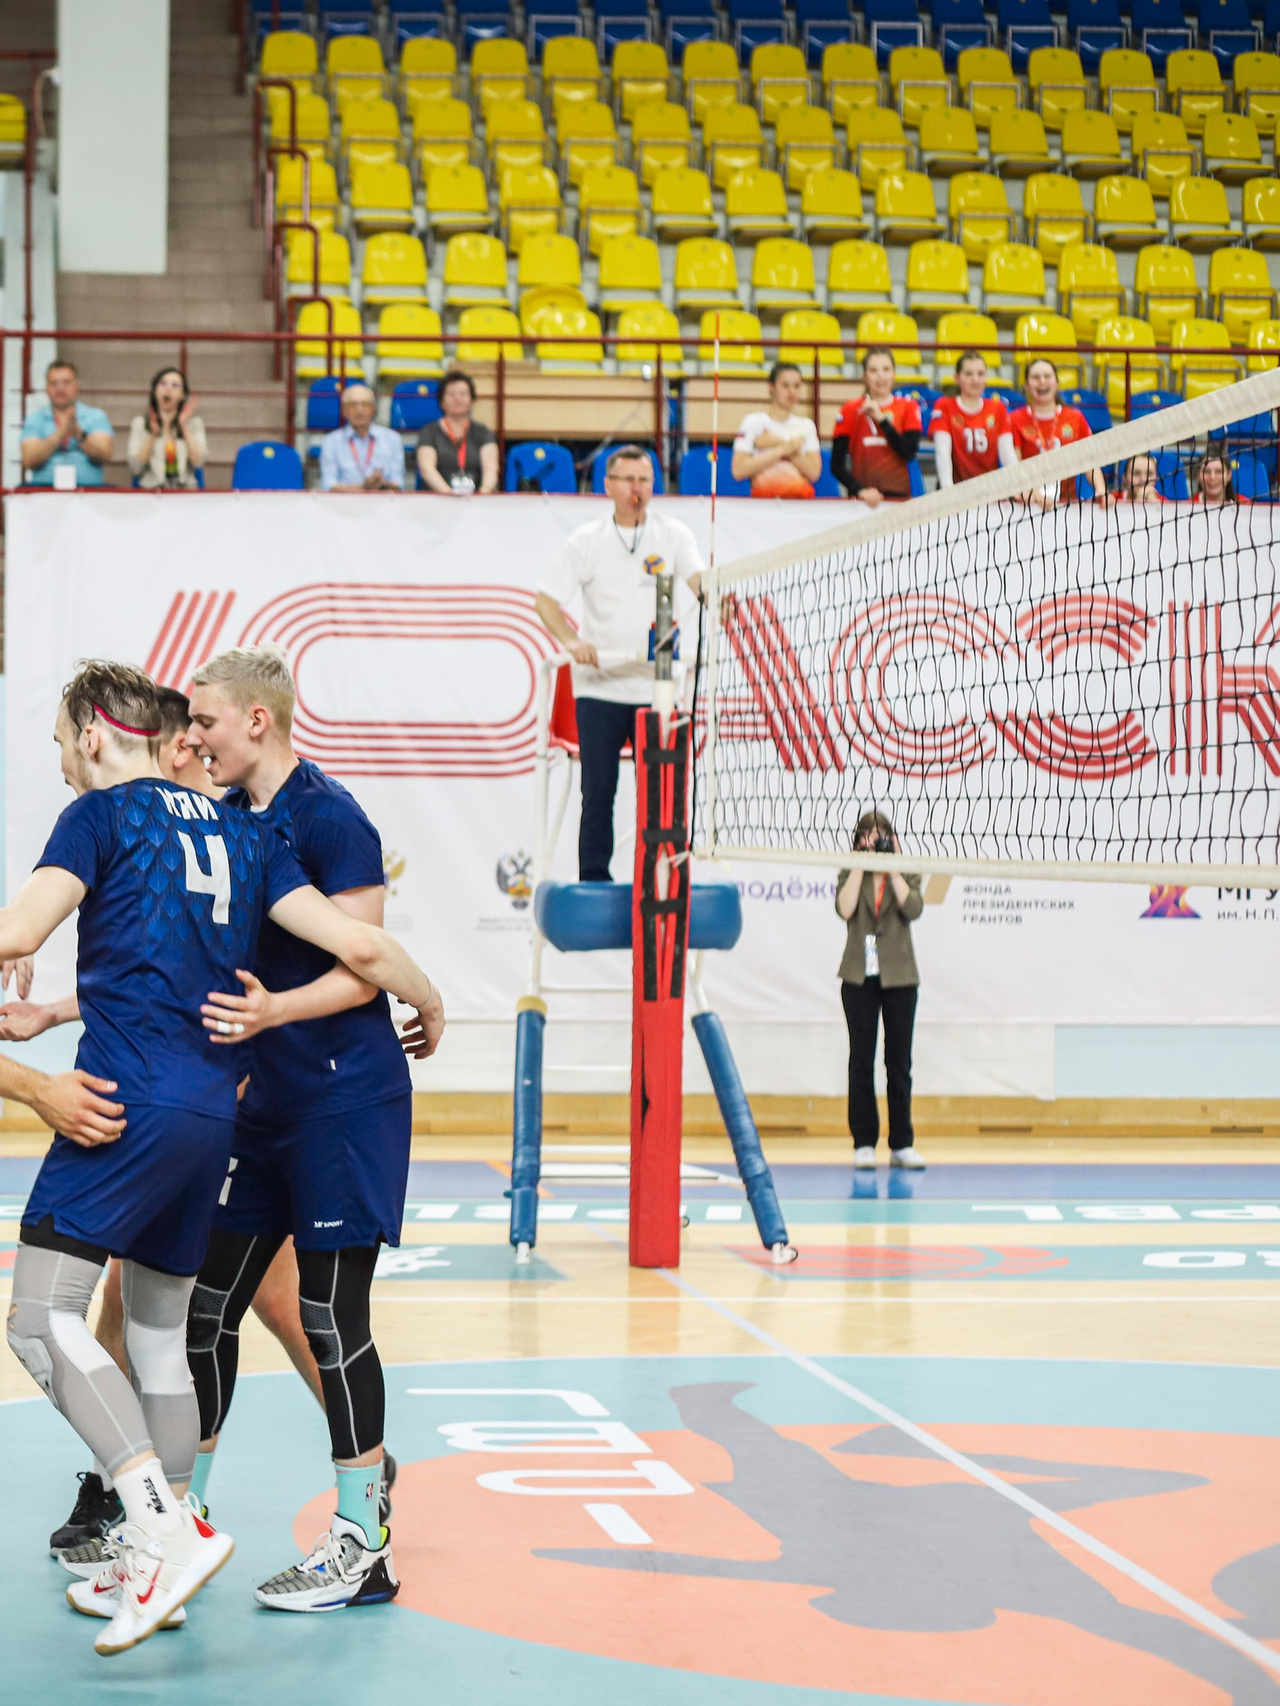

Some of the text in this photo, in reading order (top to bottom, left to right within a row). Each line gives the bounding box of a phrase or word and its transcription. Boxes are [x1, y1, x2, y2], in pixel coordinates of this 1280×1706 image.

[963, 427, 988, 453] 15
[177, 829, 231, 925] 4
[964, 884, 1013, 895] ФОНДА
[963, 900, 1075, 910] ПРЕЗИДЕНТСКИХ
[963, 915, 1023, 925] ГРАНТОВ
[971, 1205, 1280, 1221] PBL
